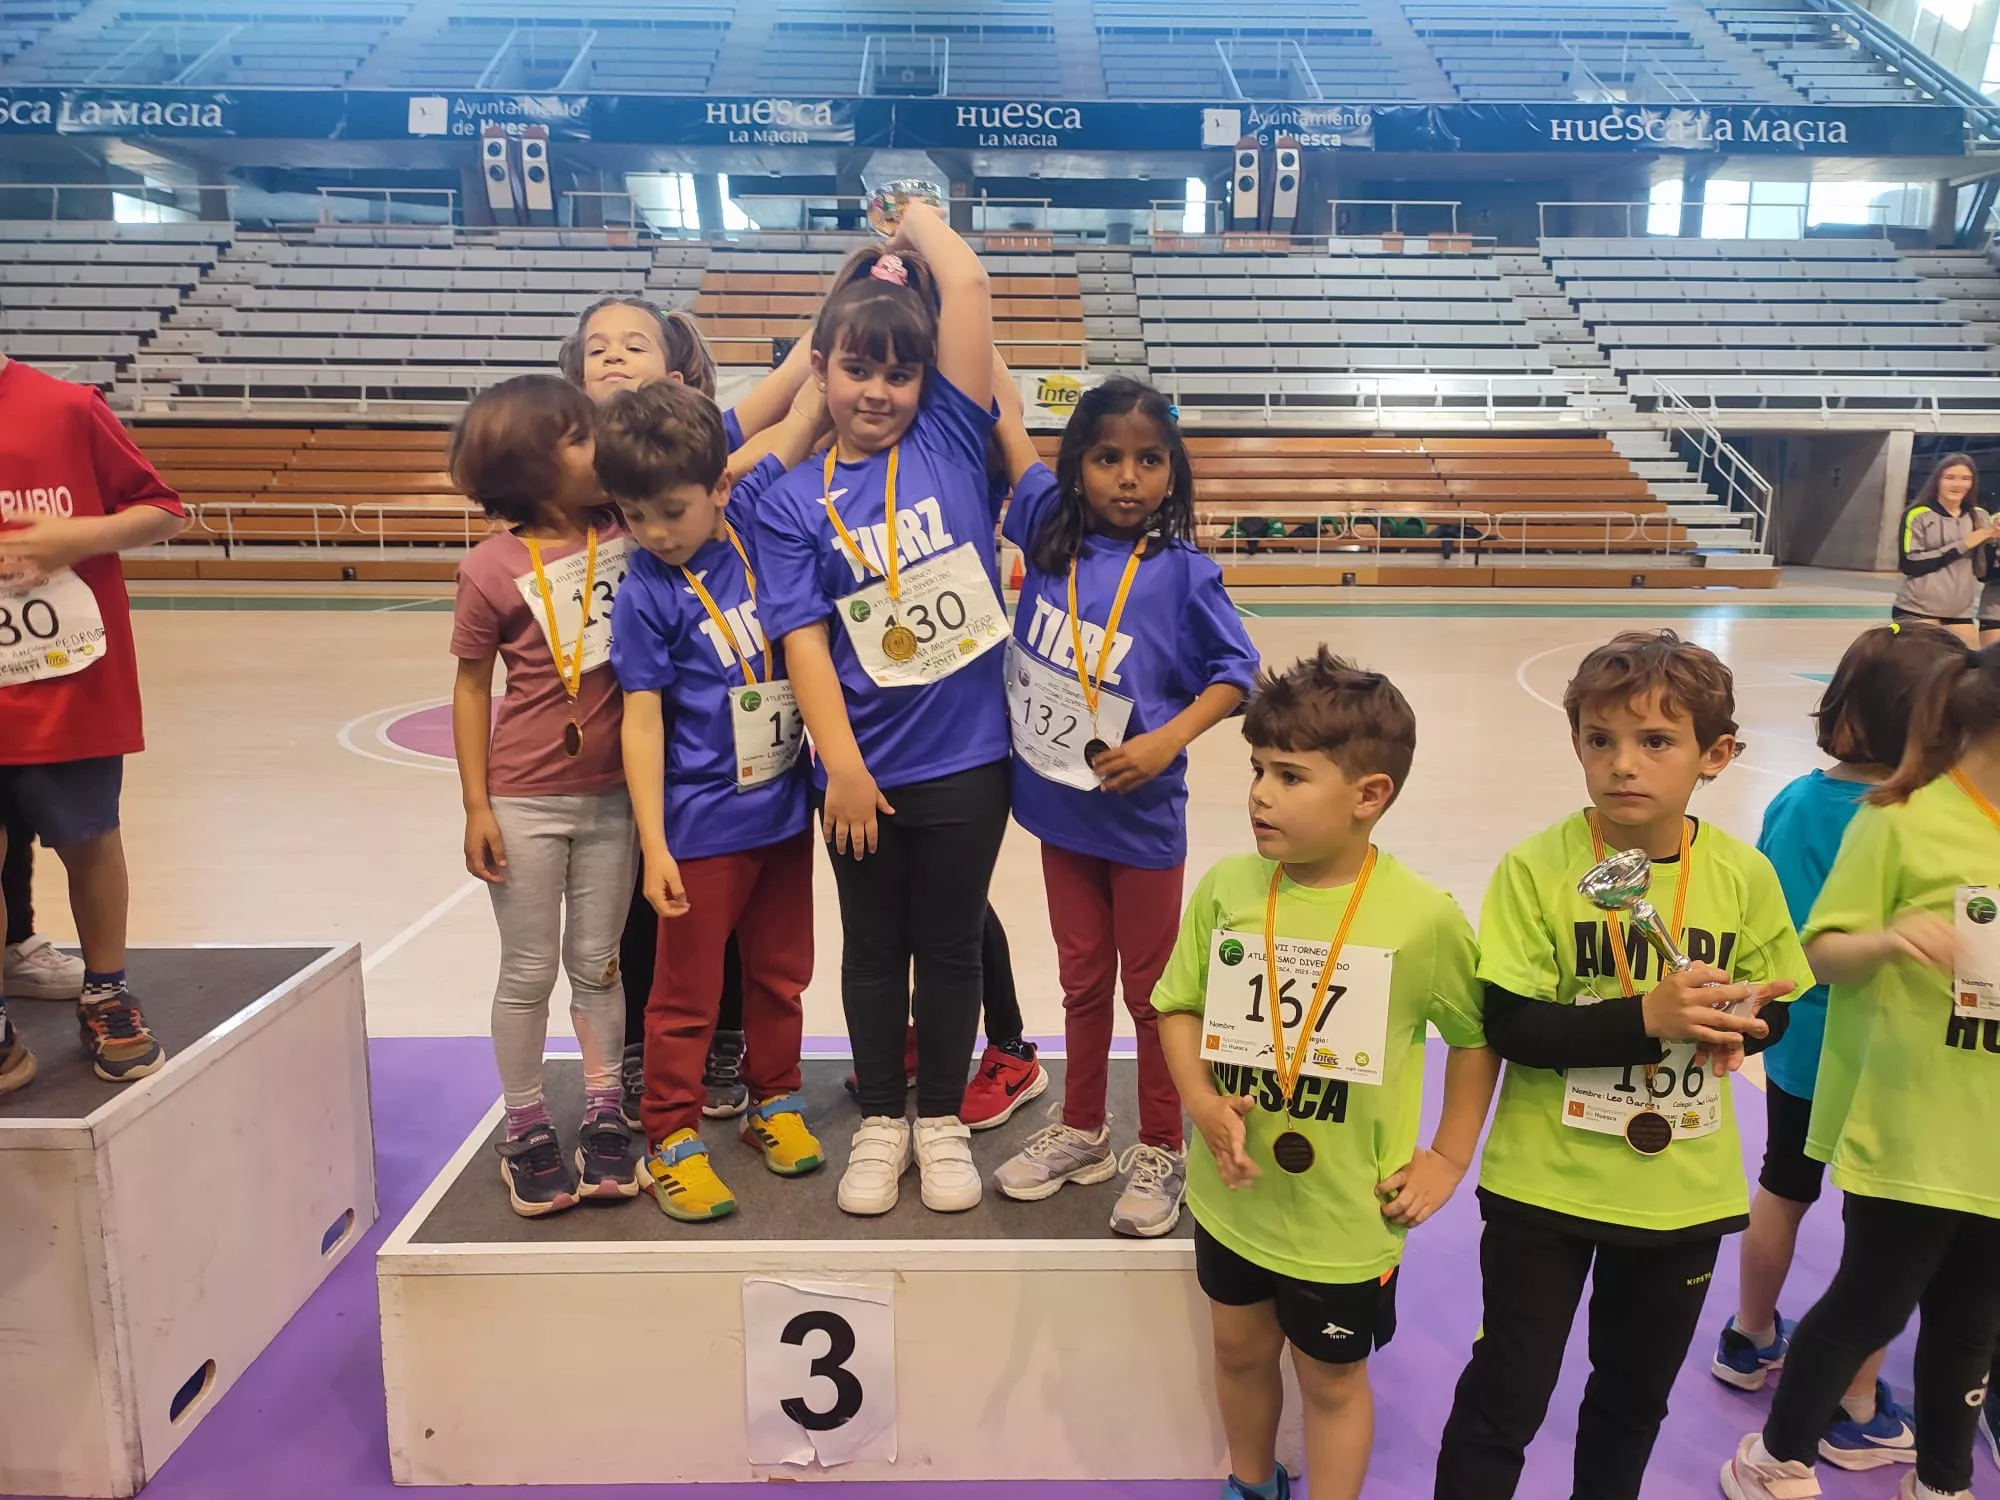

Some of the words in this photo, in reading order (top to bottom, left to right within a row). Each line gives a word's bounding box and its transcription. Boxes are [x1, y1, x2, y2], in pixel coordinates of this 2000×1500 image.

[62, 99, 102, 125] La
[956, 103, 1082, 129] Huesca
[1248, 108, 1372, 131] Ayuntamiento
[452, 119, 475, 136] de
[729, 131, 749, 144] La
[1696, 119, 1734, 141] La
[979, 134, 999, 147] La
[1023, 697, 1077, 749] 132
[1248, 952, 1297, 965] ATLESMO
[1293, 945, 1328, 957] TORNEO
[1245, 973, 1347, 1033] 167
[1606, 1092, 1623, 1102] Leo
[780, 1310, 863, 1431] 3
